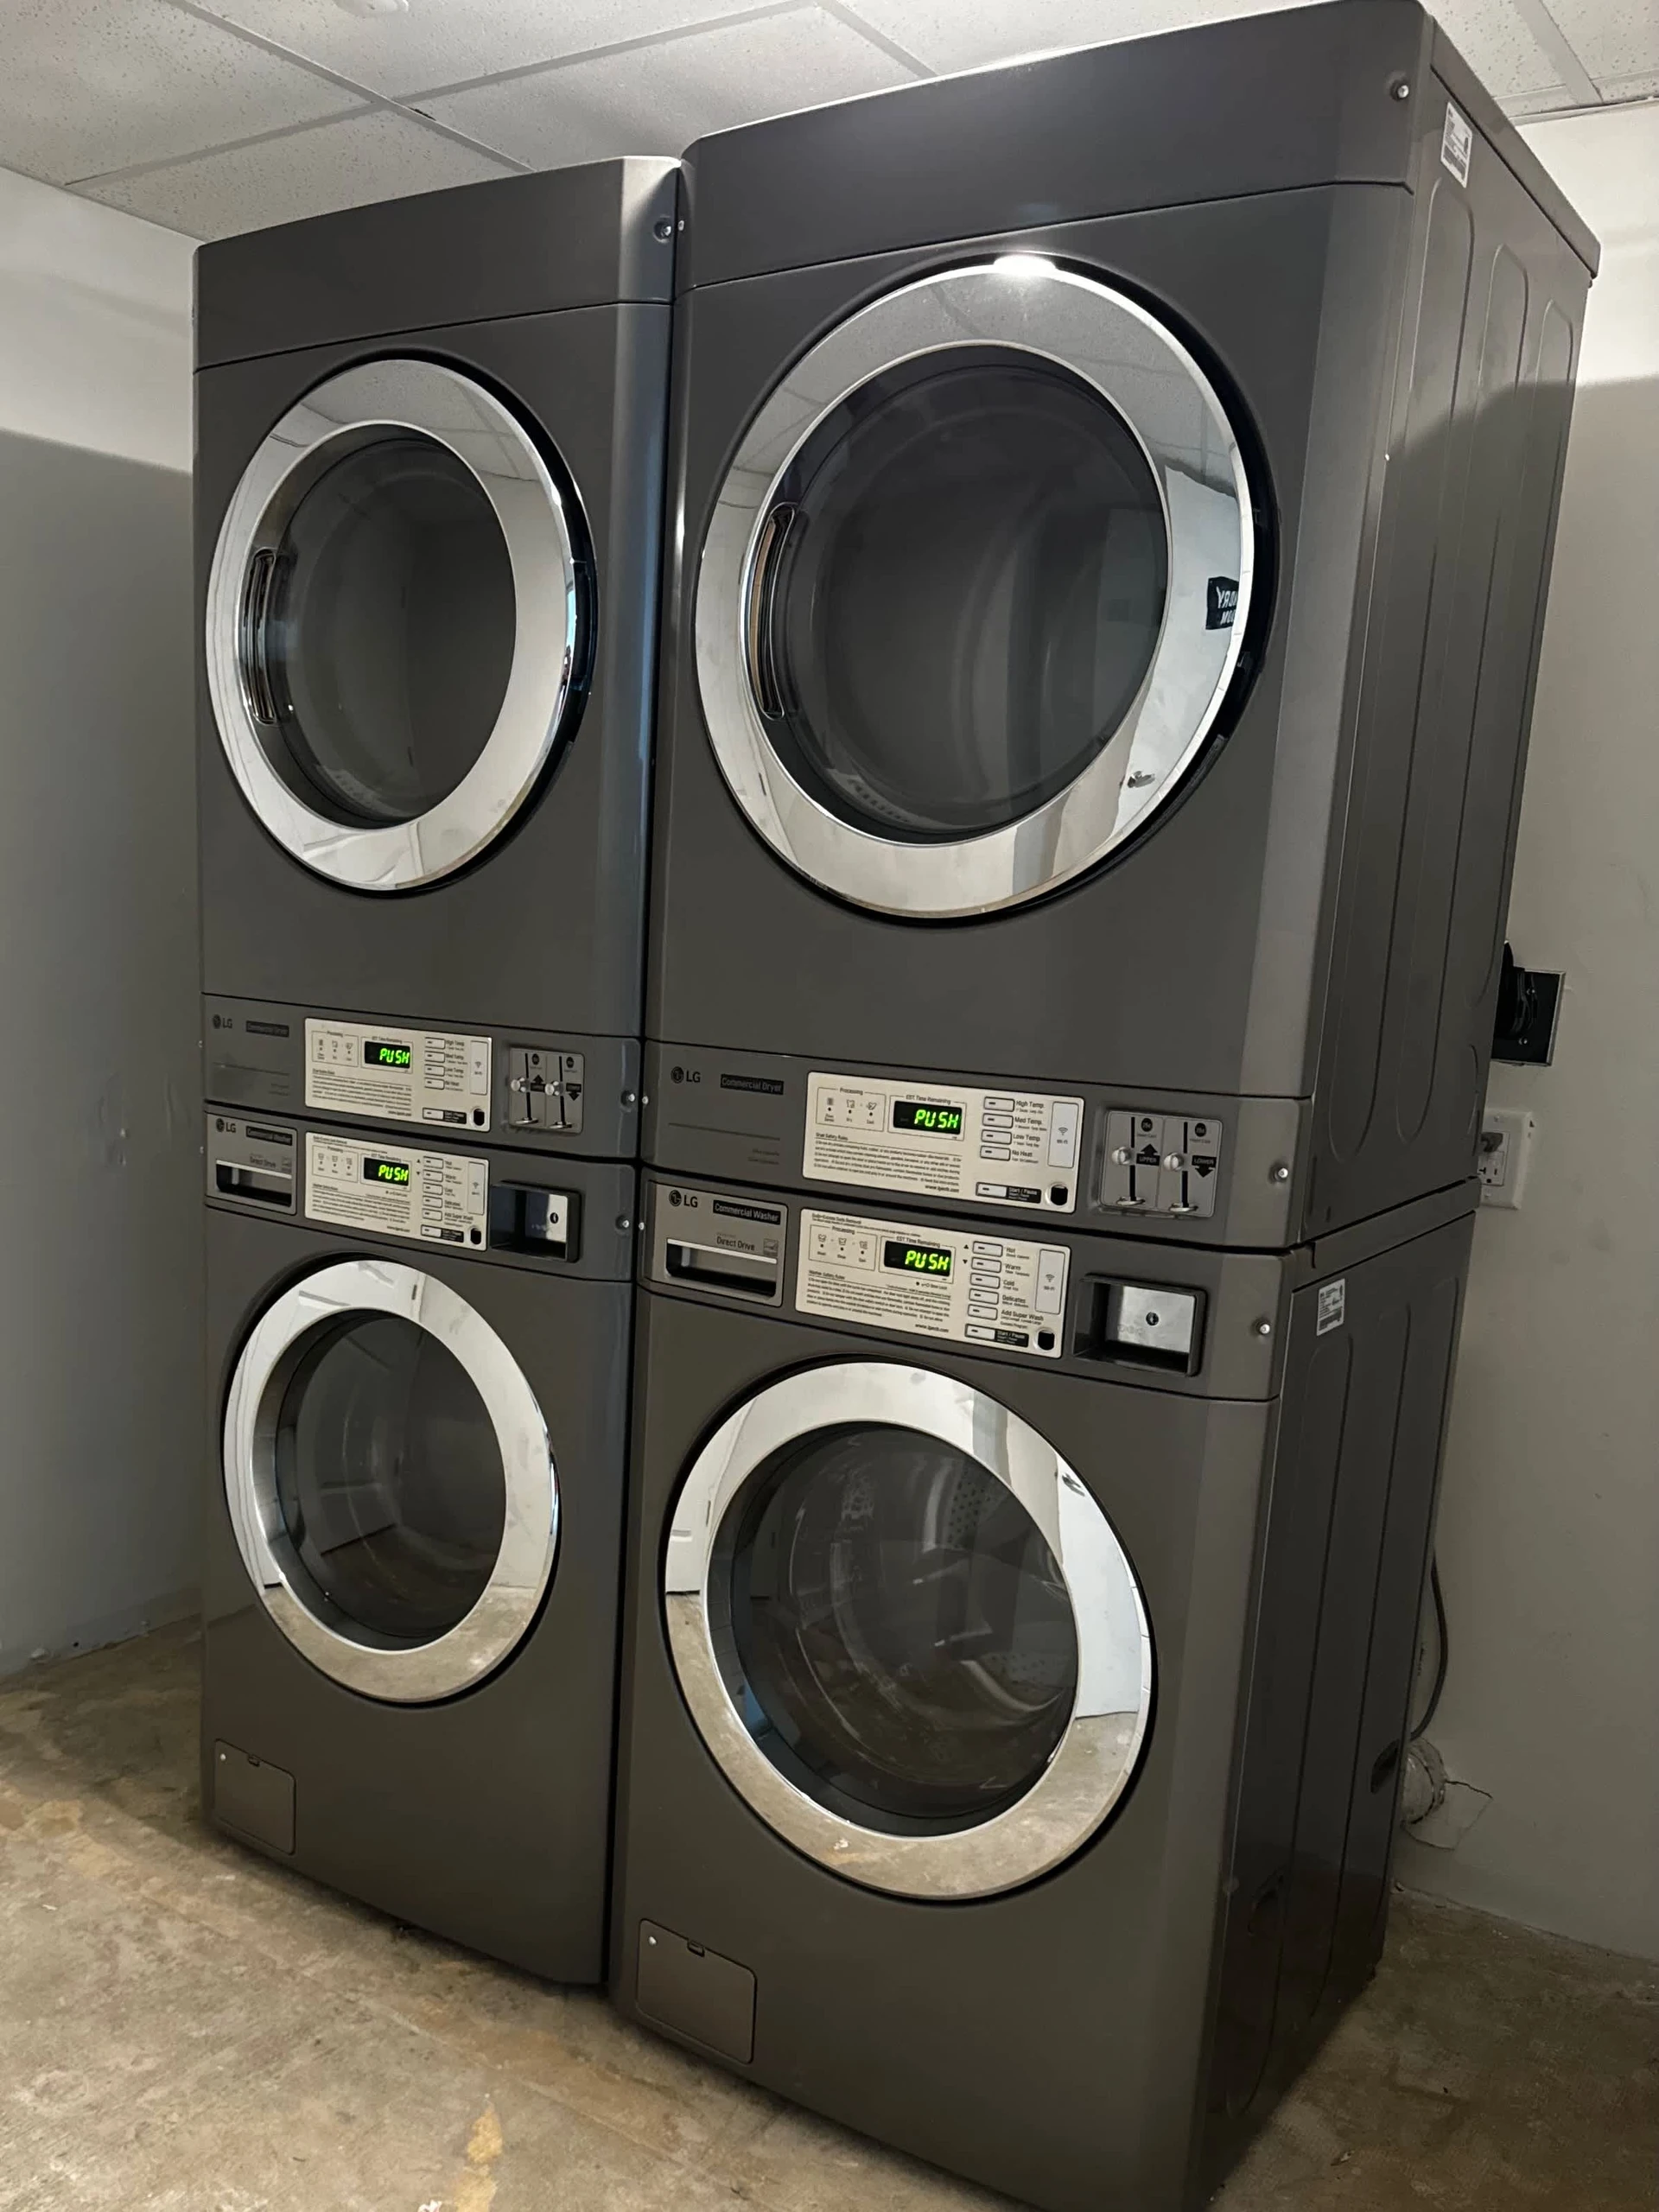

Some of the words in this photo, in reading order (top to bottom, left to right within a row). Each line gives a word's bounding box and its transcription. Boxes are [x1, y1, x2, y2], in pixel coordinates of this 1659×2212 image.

[223, 1018, 232, 1028] LG
[379, 1047, 410, 1065] PUSH
[686, 1071, 701, 1083] LG
[721, 1077, 761, 1090] Commercial
[914, 1109, 959, 1128] PUSH
[226, 1122, 236, 1134] LG
[378, 1165, 409, 1181] PUSH
[683, 1195, 698, 1208] LG
[715, 1203, 752, 1217] Commercial
[753, 1210, 779, 1222] Washer
[831, 1225, 855, 1235] Processing
[716, 1236, 736, 1247] Direct
[737, 1240, 755, 1251] Drive
[905, 1250, 949, 1270] PUSH
[1002, 1294, 1027, 1303] Delicates
[1013, 1311, 1027, 1319] Super
